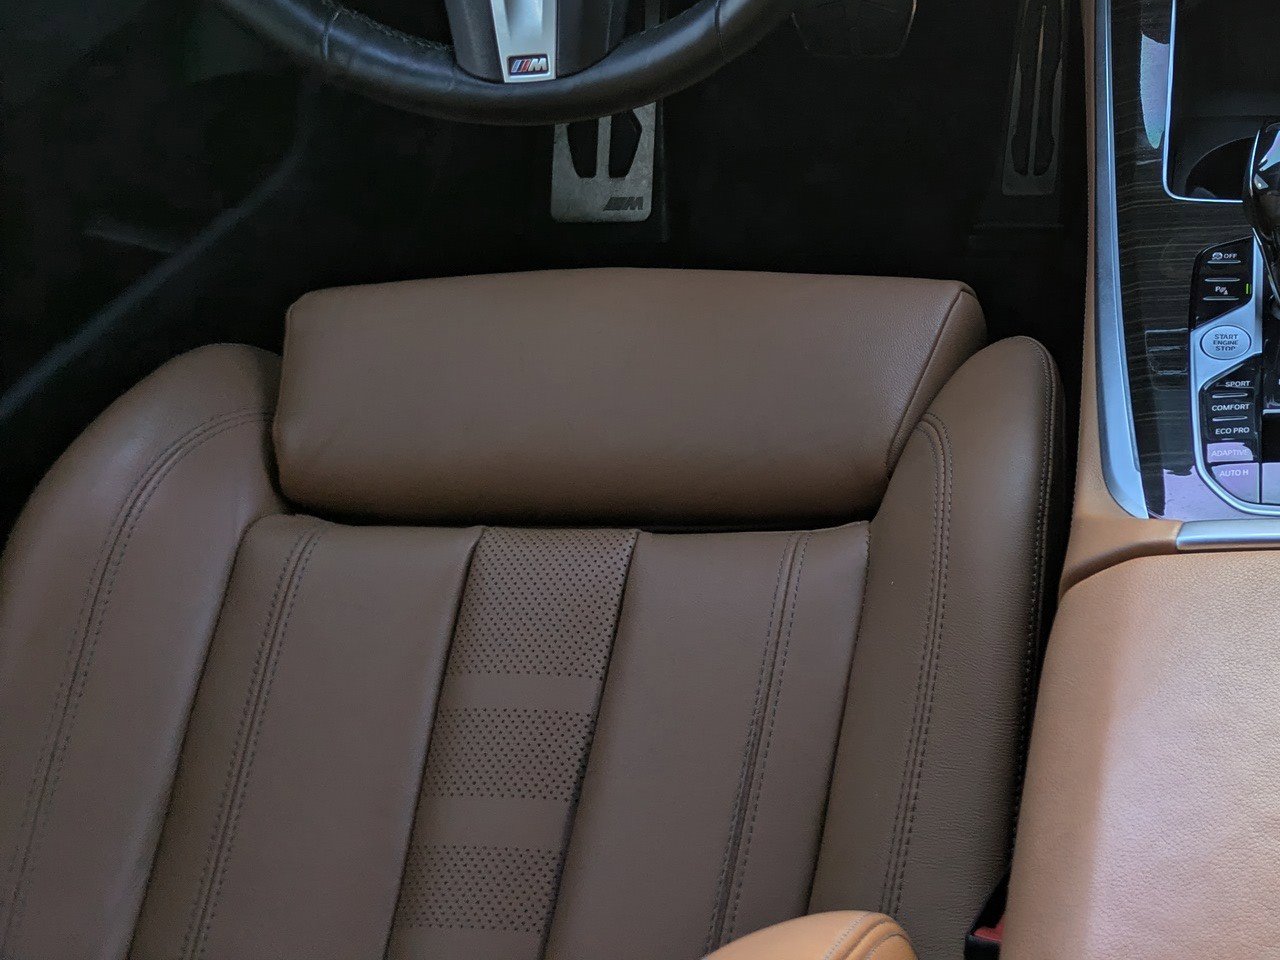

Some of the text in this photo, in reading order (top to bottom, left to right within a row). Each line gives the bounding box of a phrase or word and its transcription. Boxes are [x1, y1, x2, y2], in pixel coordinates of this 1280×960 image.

[1211, 403, 1250, 411] COMFORT
[1215, 427, 1232, 435] ECO
[1211, 449, 1250, 457] ADAPTIVE
